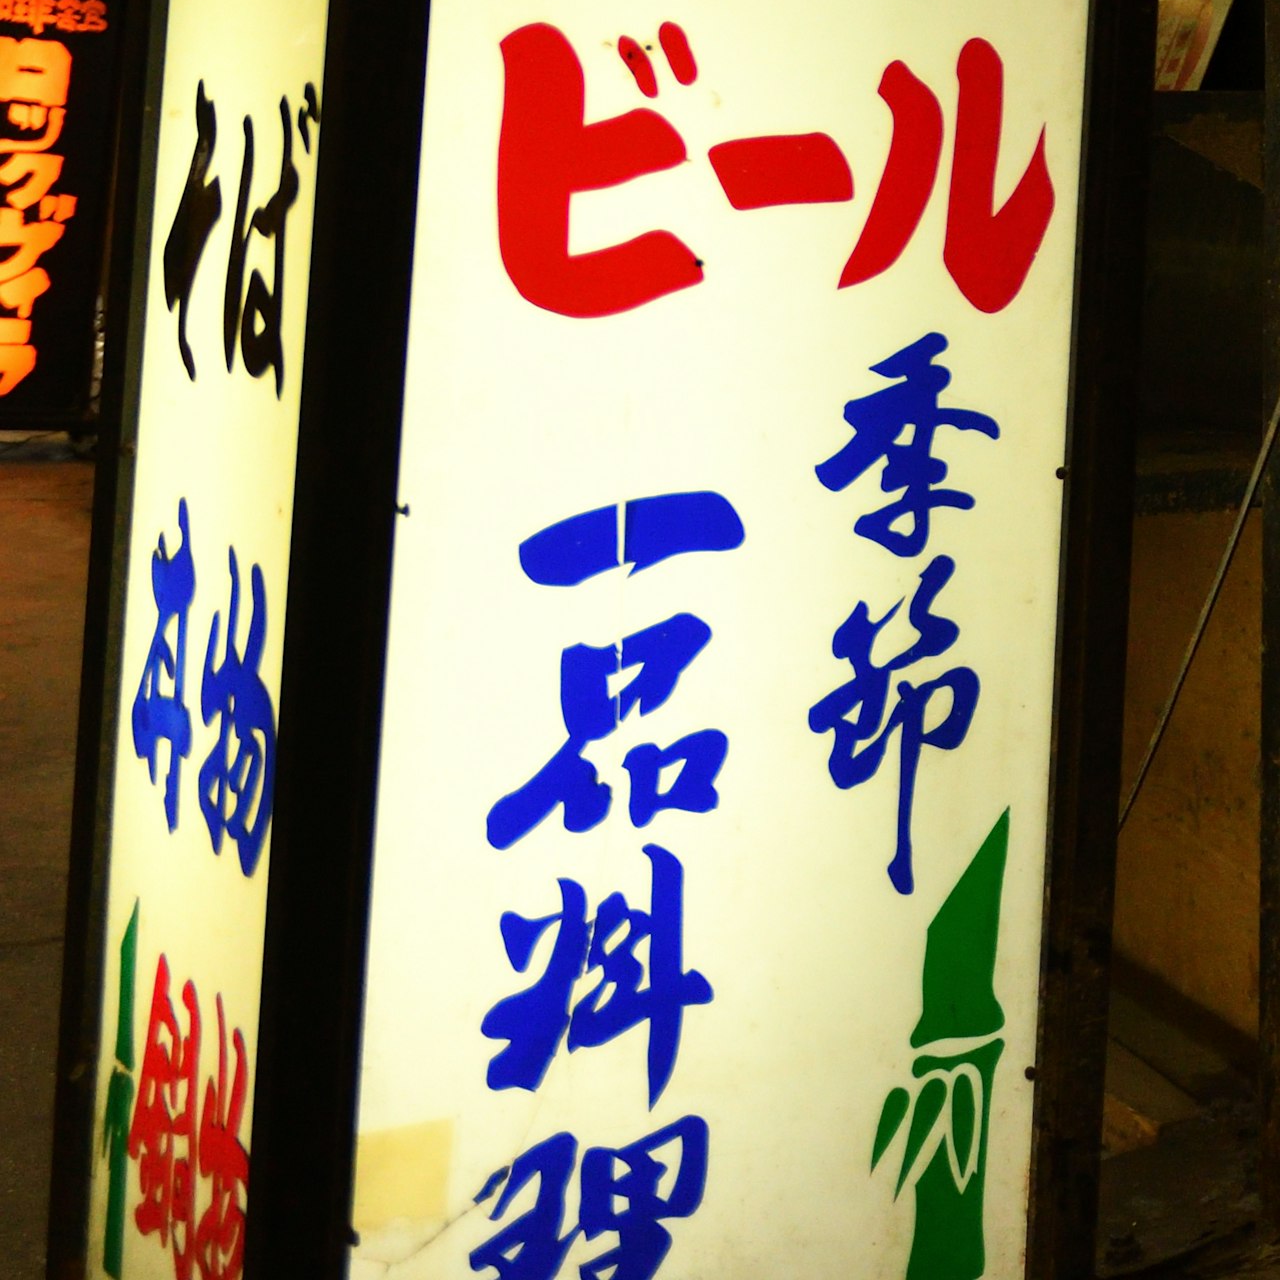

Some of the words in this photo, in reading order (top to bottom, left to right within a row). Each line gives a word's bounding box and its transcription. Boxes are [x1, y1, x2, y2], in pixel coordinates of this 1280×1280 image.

[164, 78, 323, 399] そば
[497, 20, 1055, 318] ビール
[809, 331, 1001, 895] 季節
[464, 488, 746, 1280] 一品料理
